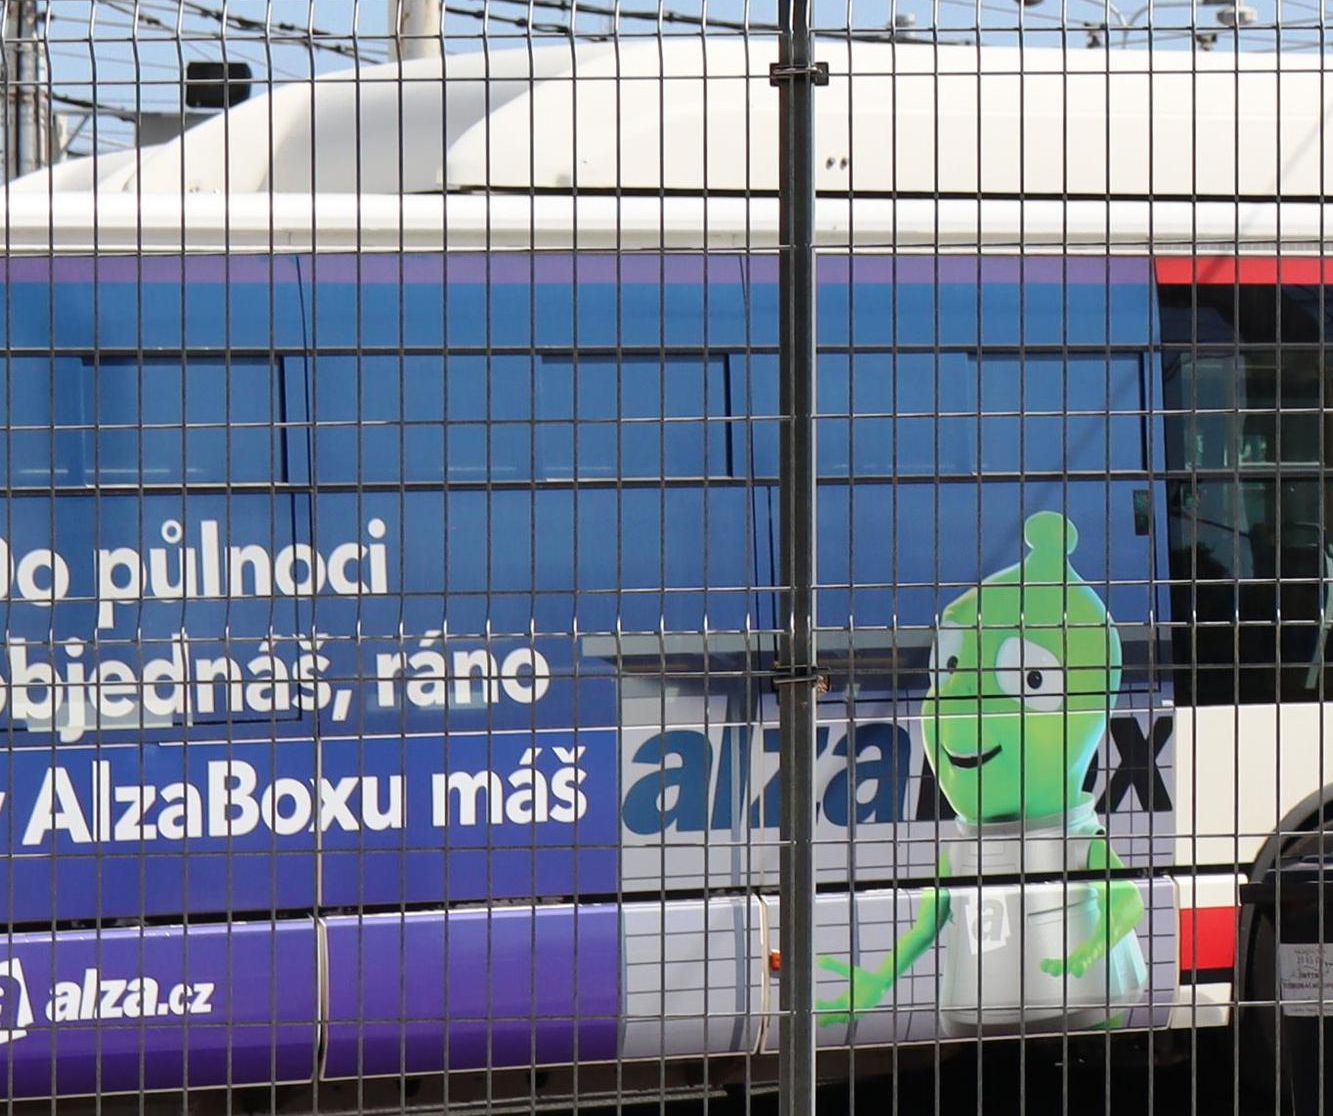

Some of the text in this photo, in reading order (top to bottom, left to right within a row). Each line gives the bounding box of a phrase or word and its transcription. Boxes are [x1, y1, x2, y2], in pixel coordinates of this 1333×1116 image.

[0, 518, 388, 628] o půlnoci
[0, 629, 550, 742] bjednáš, ráno
[22, 746, 588, 846] AlzaBoxu máš
[621, 699, 1173, 836] alzax
[46, 968, 215, 1022] alza.cz
